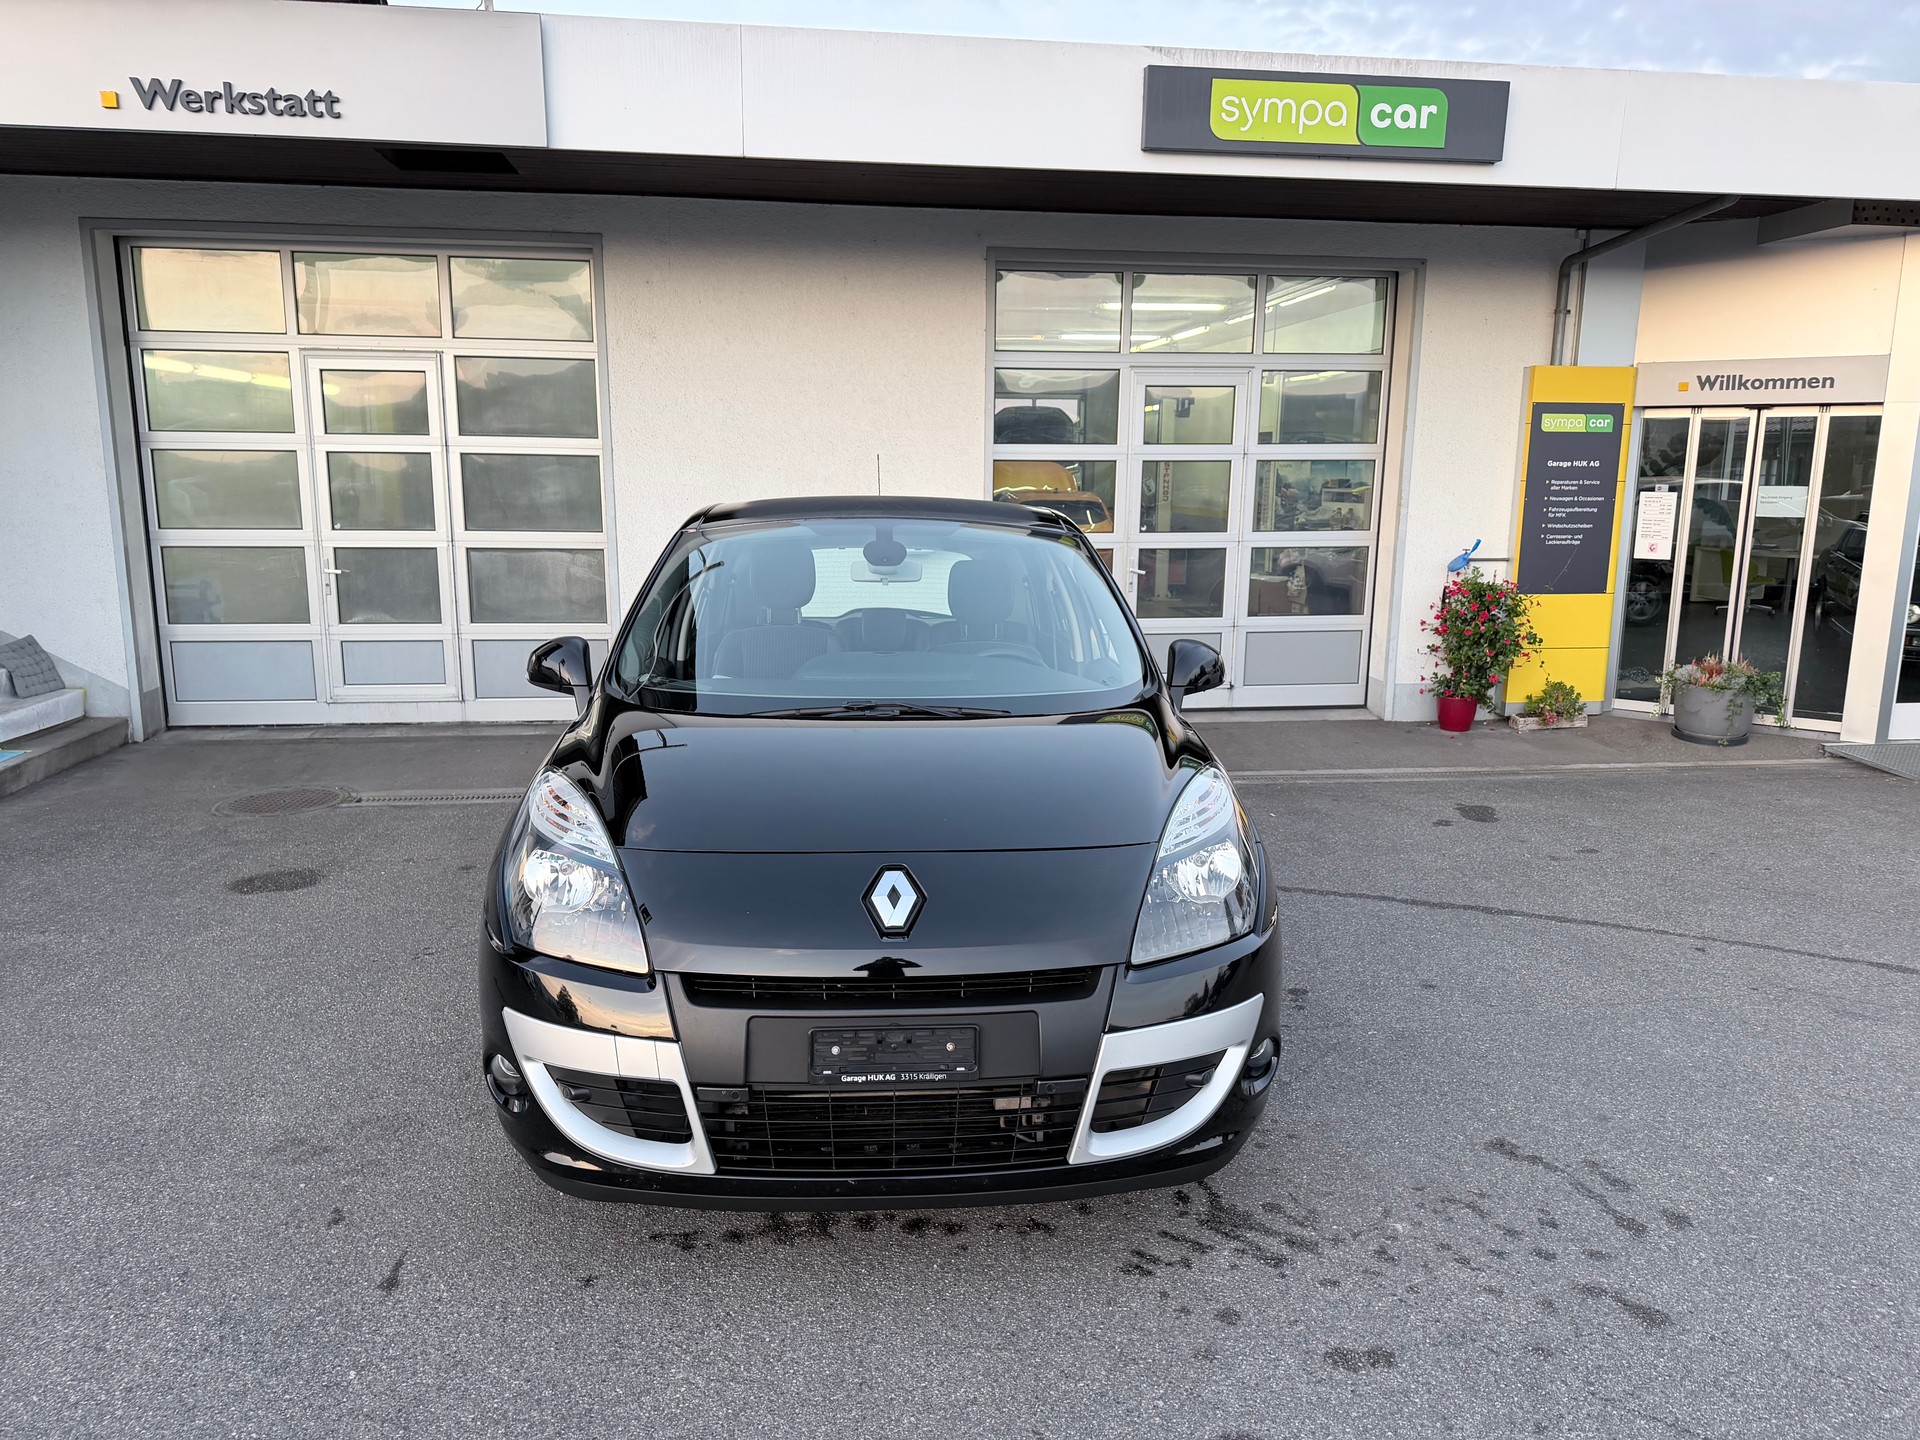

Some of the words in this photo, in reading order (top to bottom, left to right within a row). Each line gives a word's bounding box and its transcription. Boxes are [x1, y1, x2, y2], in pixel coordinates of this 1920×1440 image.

[128, 76, 341, 119] Werkstatt
[1220, 94, 1348, 134] sympa
[1369, 102, 1438, 130] car
[1696, 374, 1835, 392] Willkommen
[1544, 418, 1583, 430] sympa
[1589, 418, 1610, 428] car
[1547, 460, 1572, 468] Garage
[841, 1075, 866, 1083] Garage
[885, 1073, 896, 1081] AG
[900, 1073, 918, 1081] 3315
